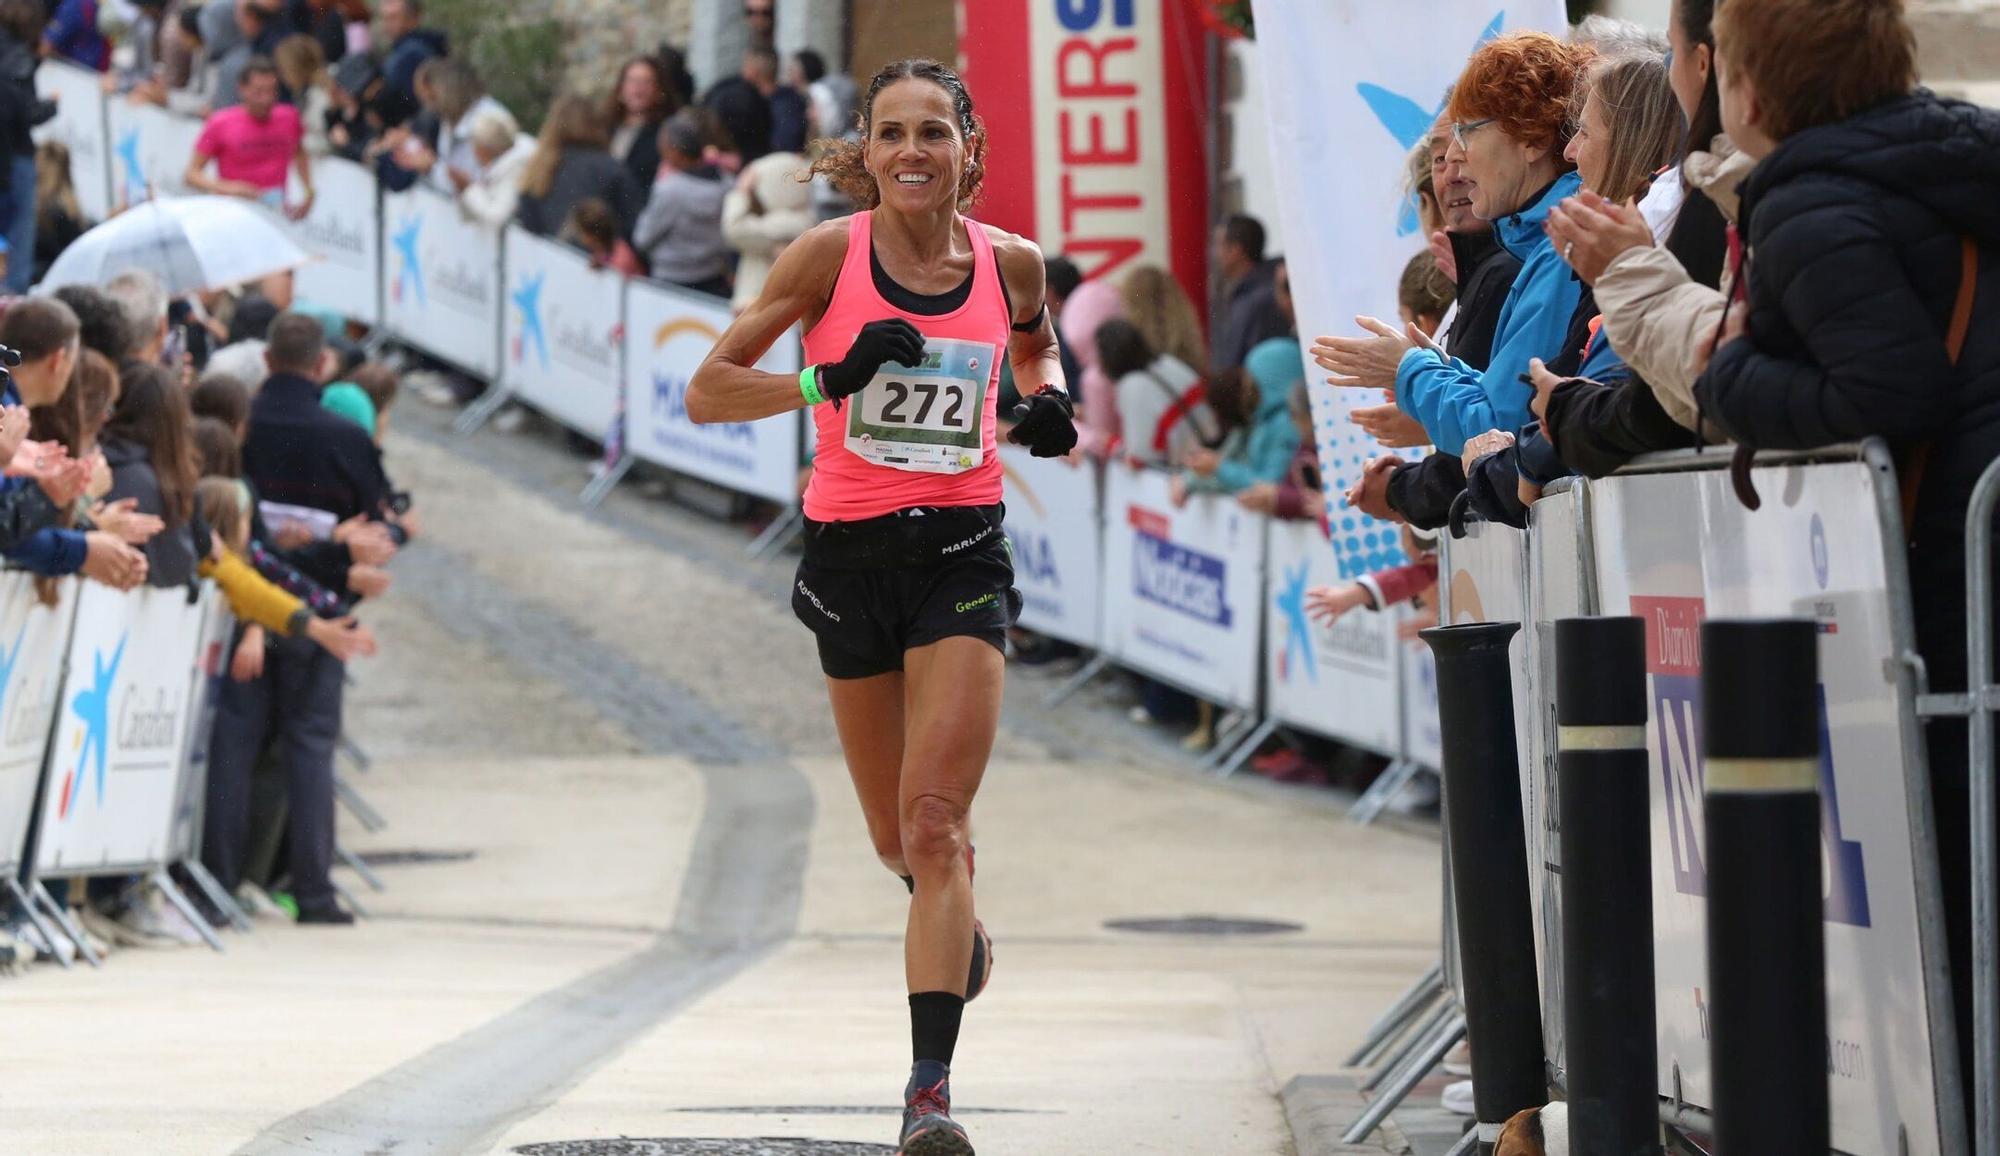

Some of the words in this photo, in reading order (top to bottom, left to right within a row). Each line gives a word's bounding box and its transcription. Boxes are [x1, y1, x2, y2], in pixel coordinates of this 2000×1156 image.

[1056, 0, 1145, 283] NTERS
[880, 381, 964, 427] 272
[1656, 607, 1692, 666] Diario
